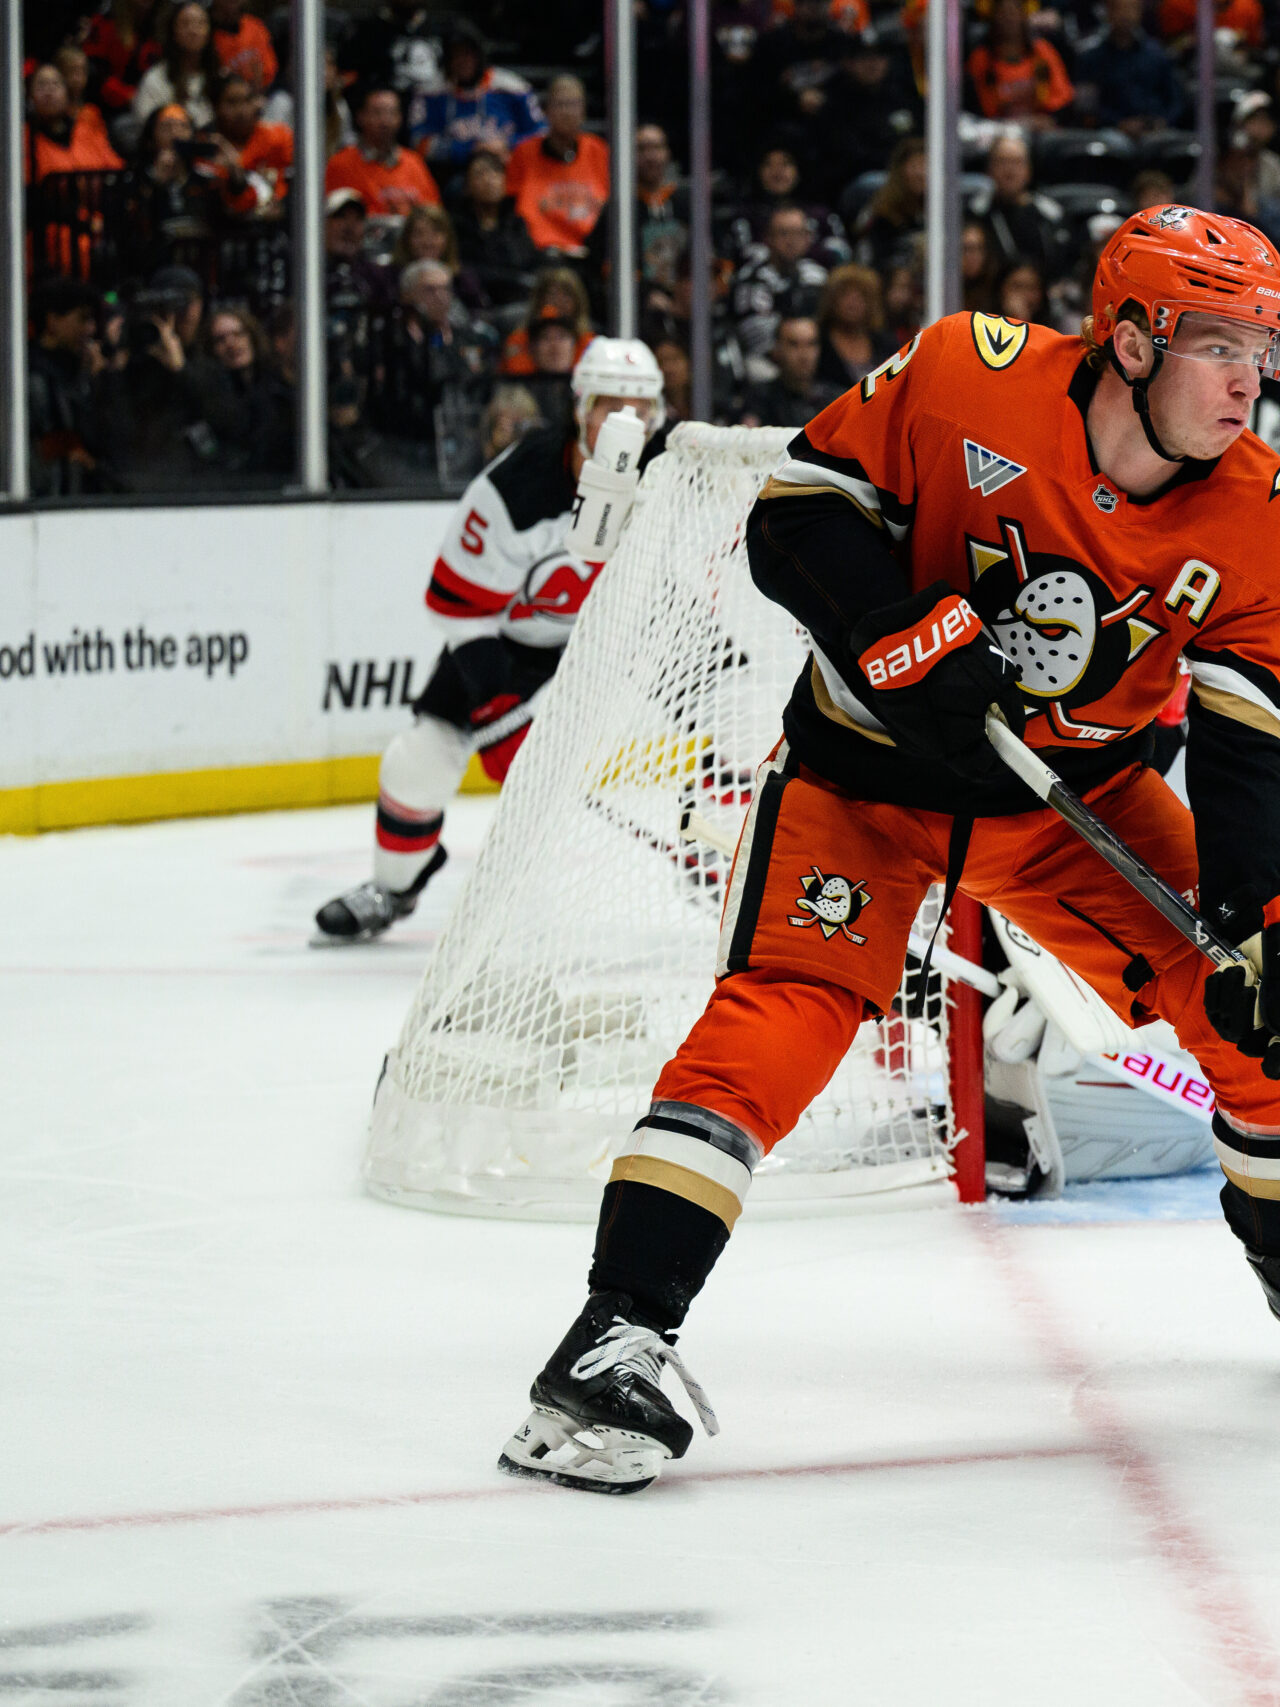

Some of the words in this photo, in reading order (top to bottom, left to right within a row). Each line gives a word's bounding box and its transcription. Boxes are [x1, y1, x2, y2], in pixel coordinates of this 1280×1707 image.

[460, 508, 489, 556] 5
[1163, 557, 1222, 630] A
[44, 626, 114, 673] with
[124, 625, 177, 671] the
[186, 632, 249, 678] app
[322, 660, 420, 711] NHL
